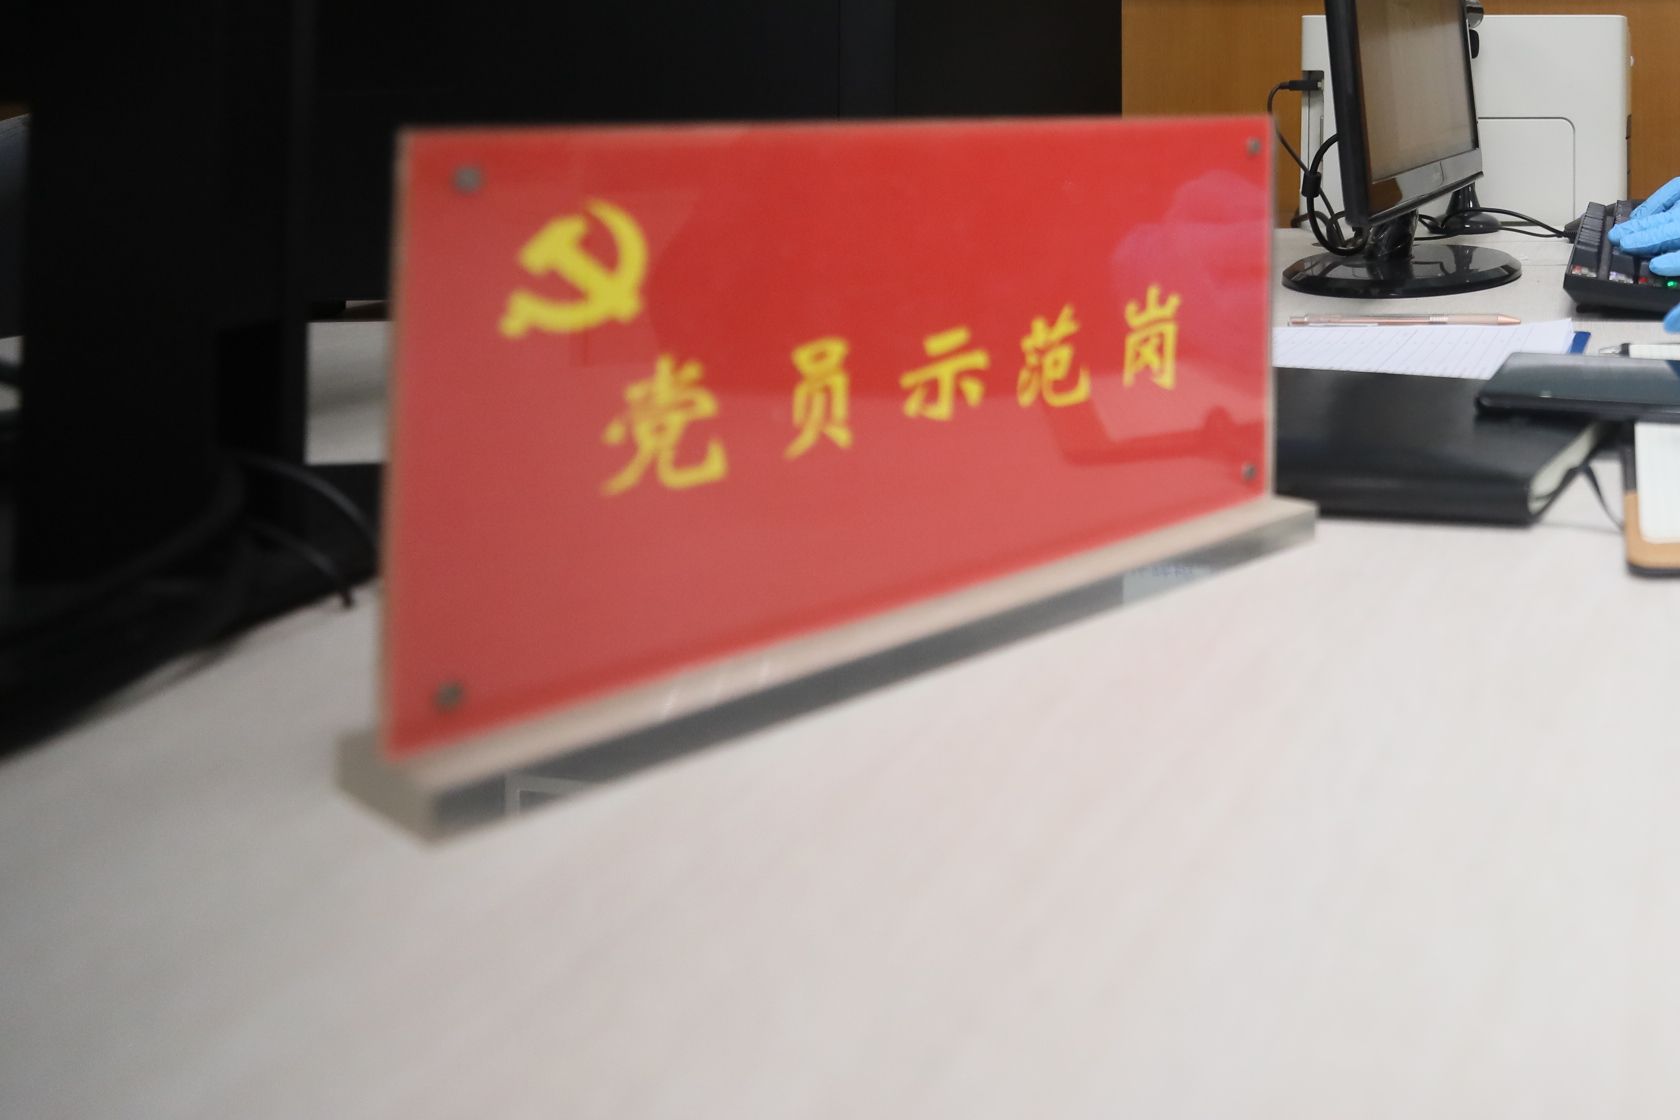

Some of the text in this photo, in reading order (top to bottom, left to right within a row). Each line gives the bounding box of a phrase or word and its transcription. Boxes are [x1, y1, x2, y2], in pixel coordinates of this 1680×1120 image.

[602, 284, 1183, 495] 党员示范岗
